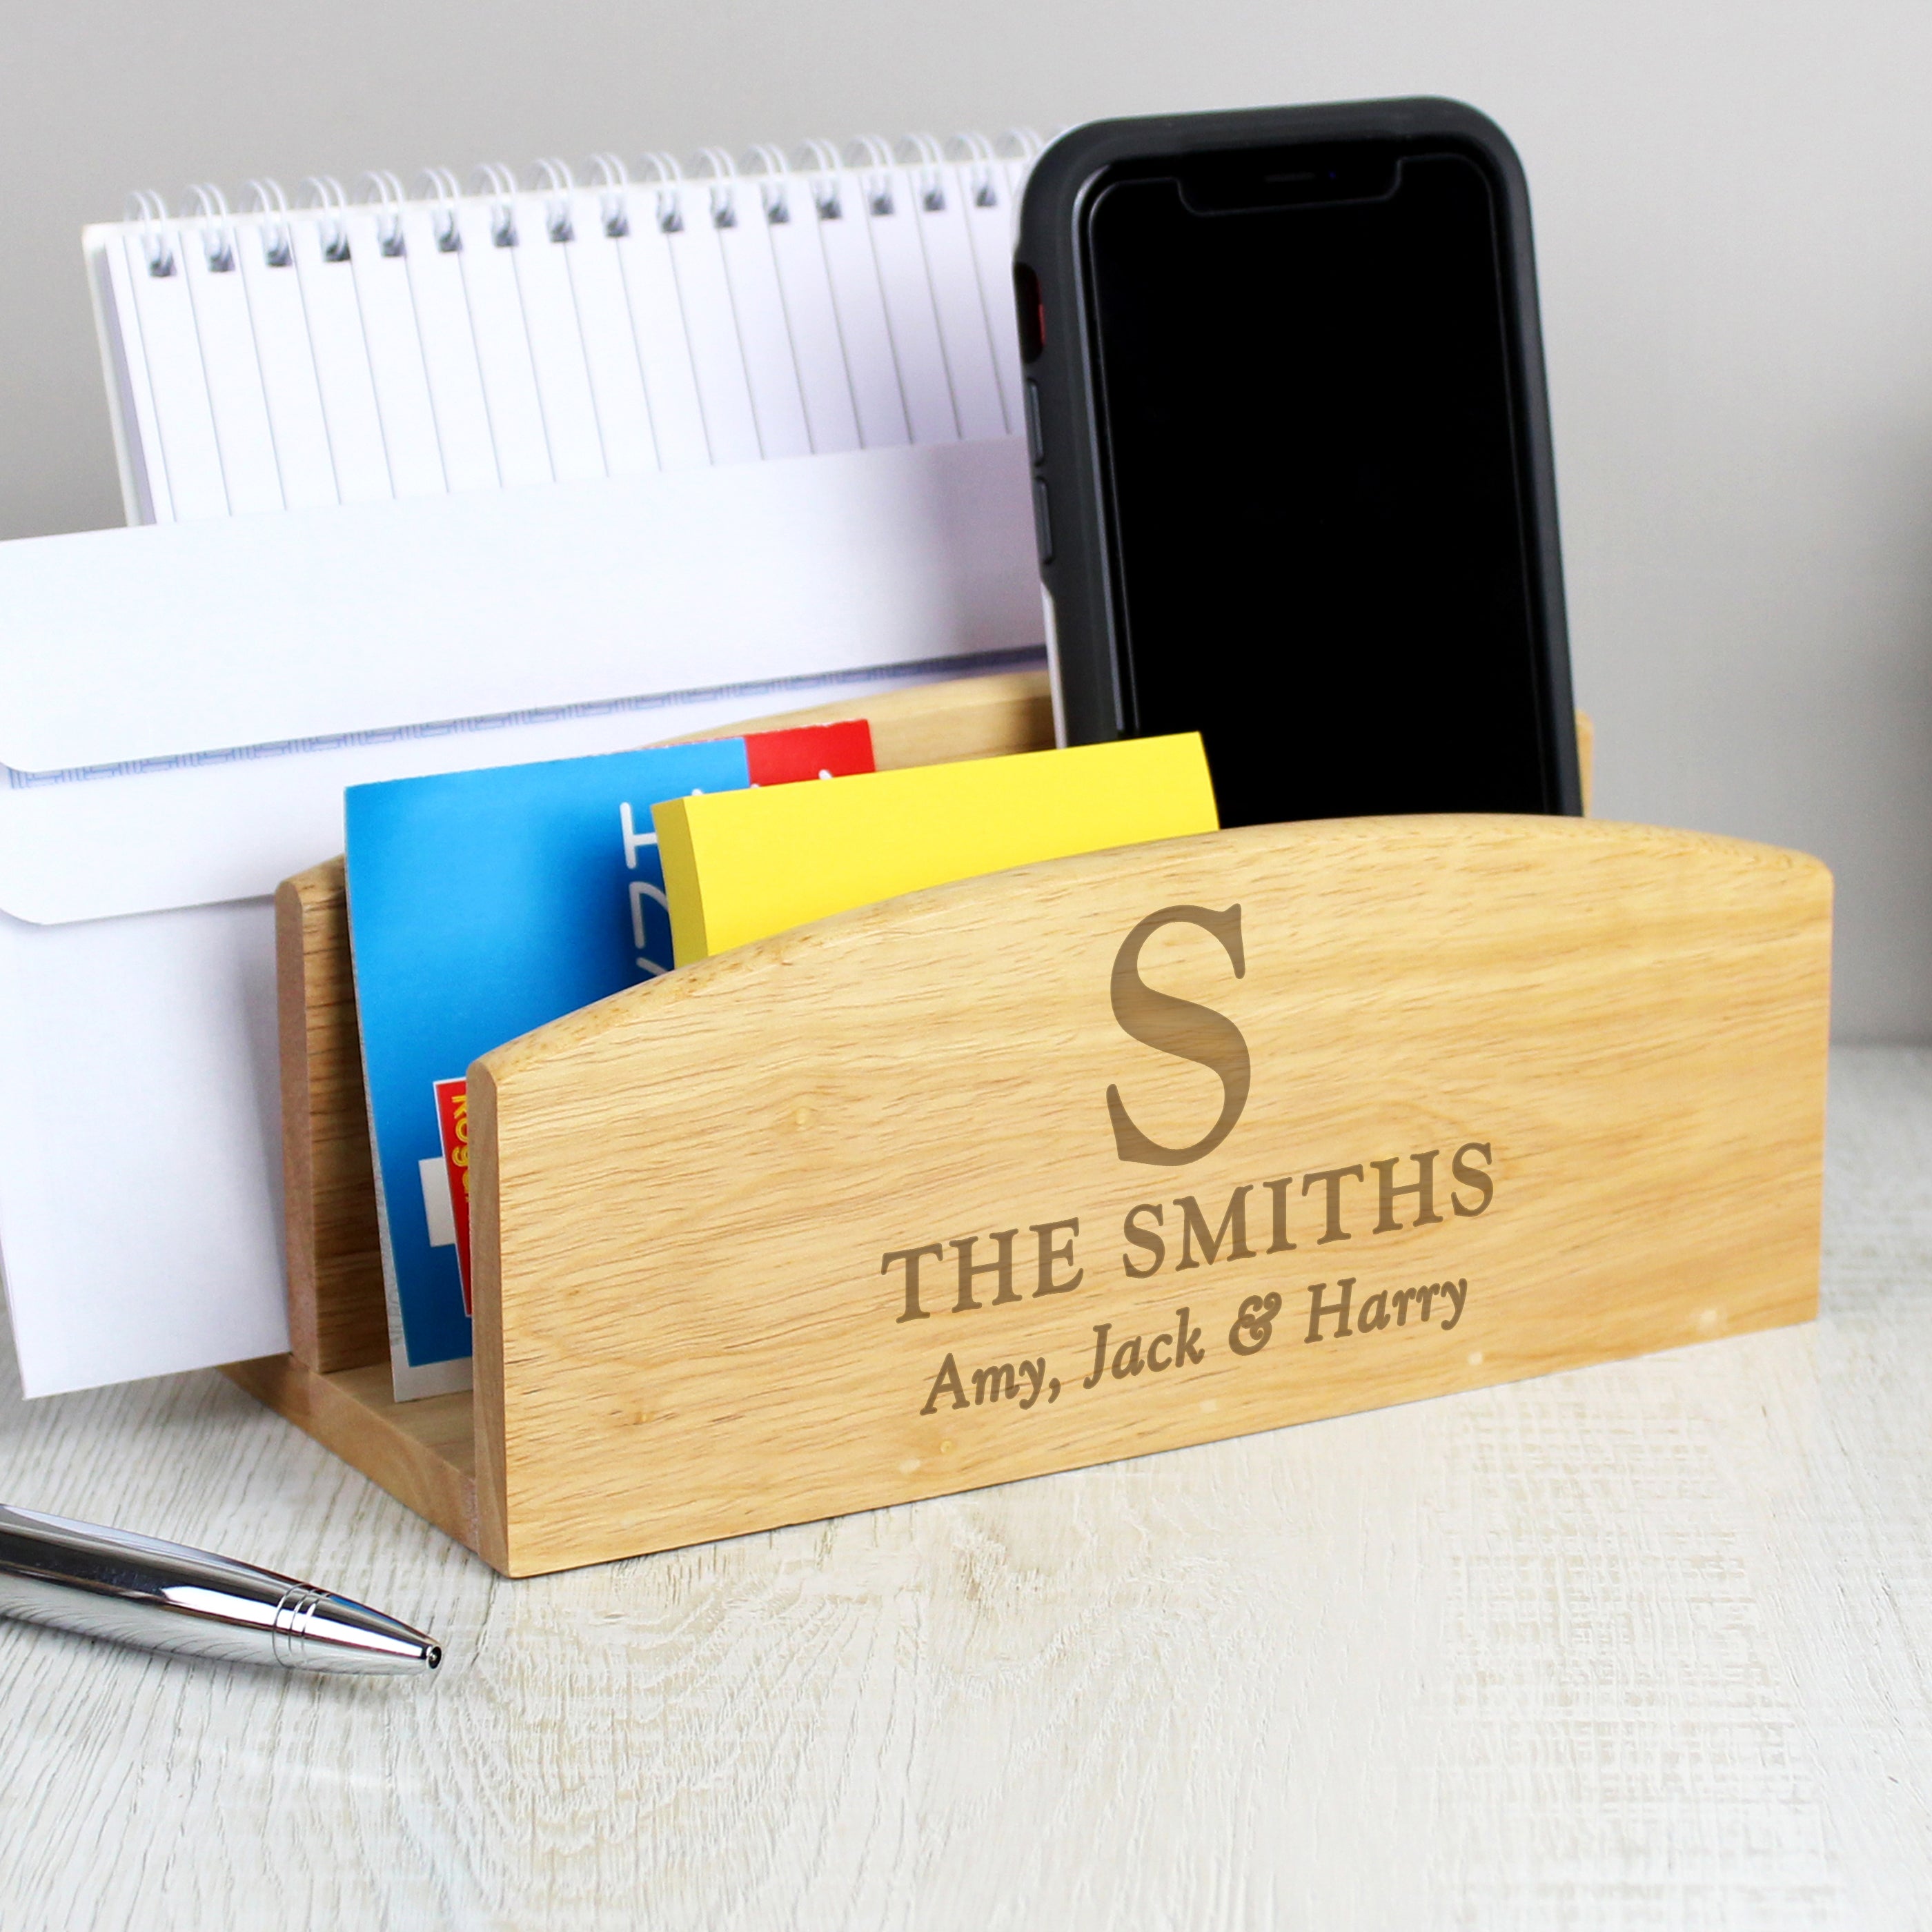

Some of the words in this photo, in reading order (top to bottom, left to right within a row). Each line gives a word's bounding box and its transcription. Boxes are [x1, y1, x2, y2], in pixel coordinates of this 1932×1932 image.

[1107, 903, 1251, 1167] S
[880, 1217, 1084, 1324] THE
[1123, 1142, 1494, 1279] SMITHS
[920, 1353, 1062, 1416] Amy,
[1083, 1307, 1205, 1390] Jack
[1228, 1292, 1282, 1357] &
[1304, 1277, 1468, 1344] Harry
